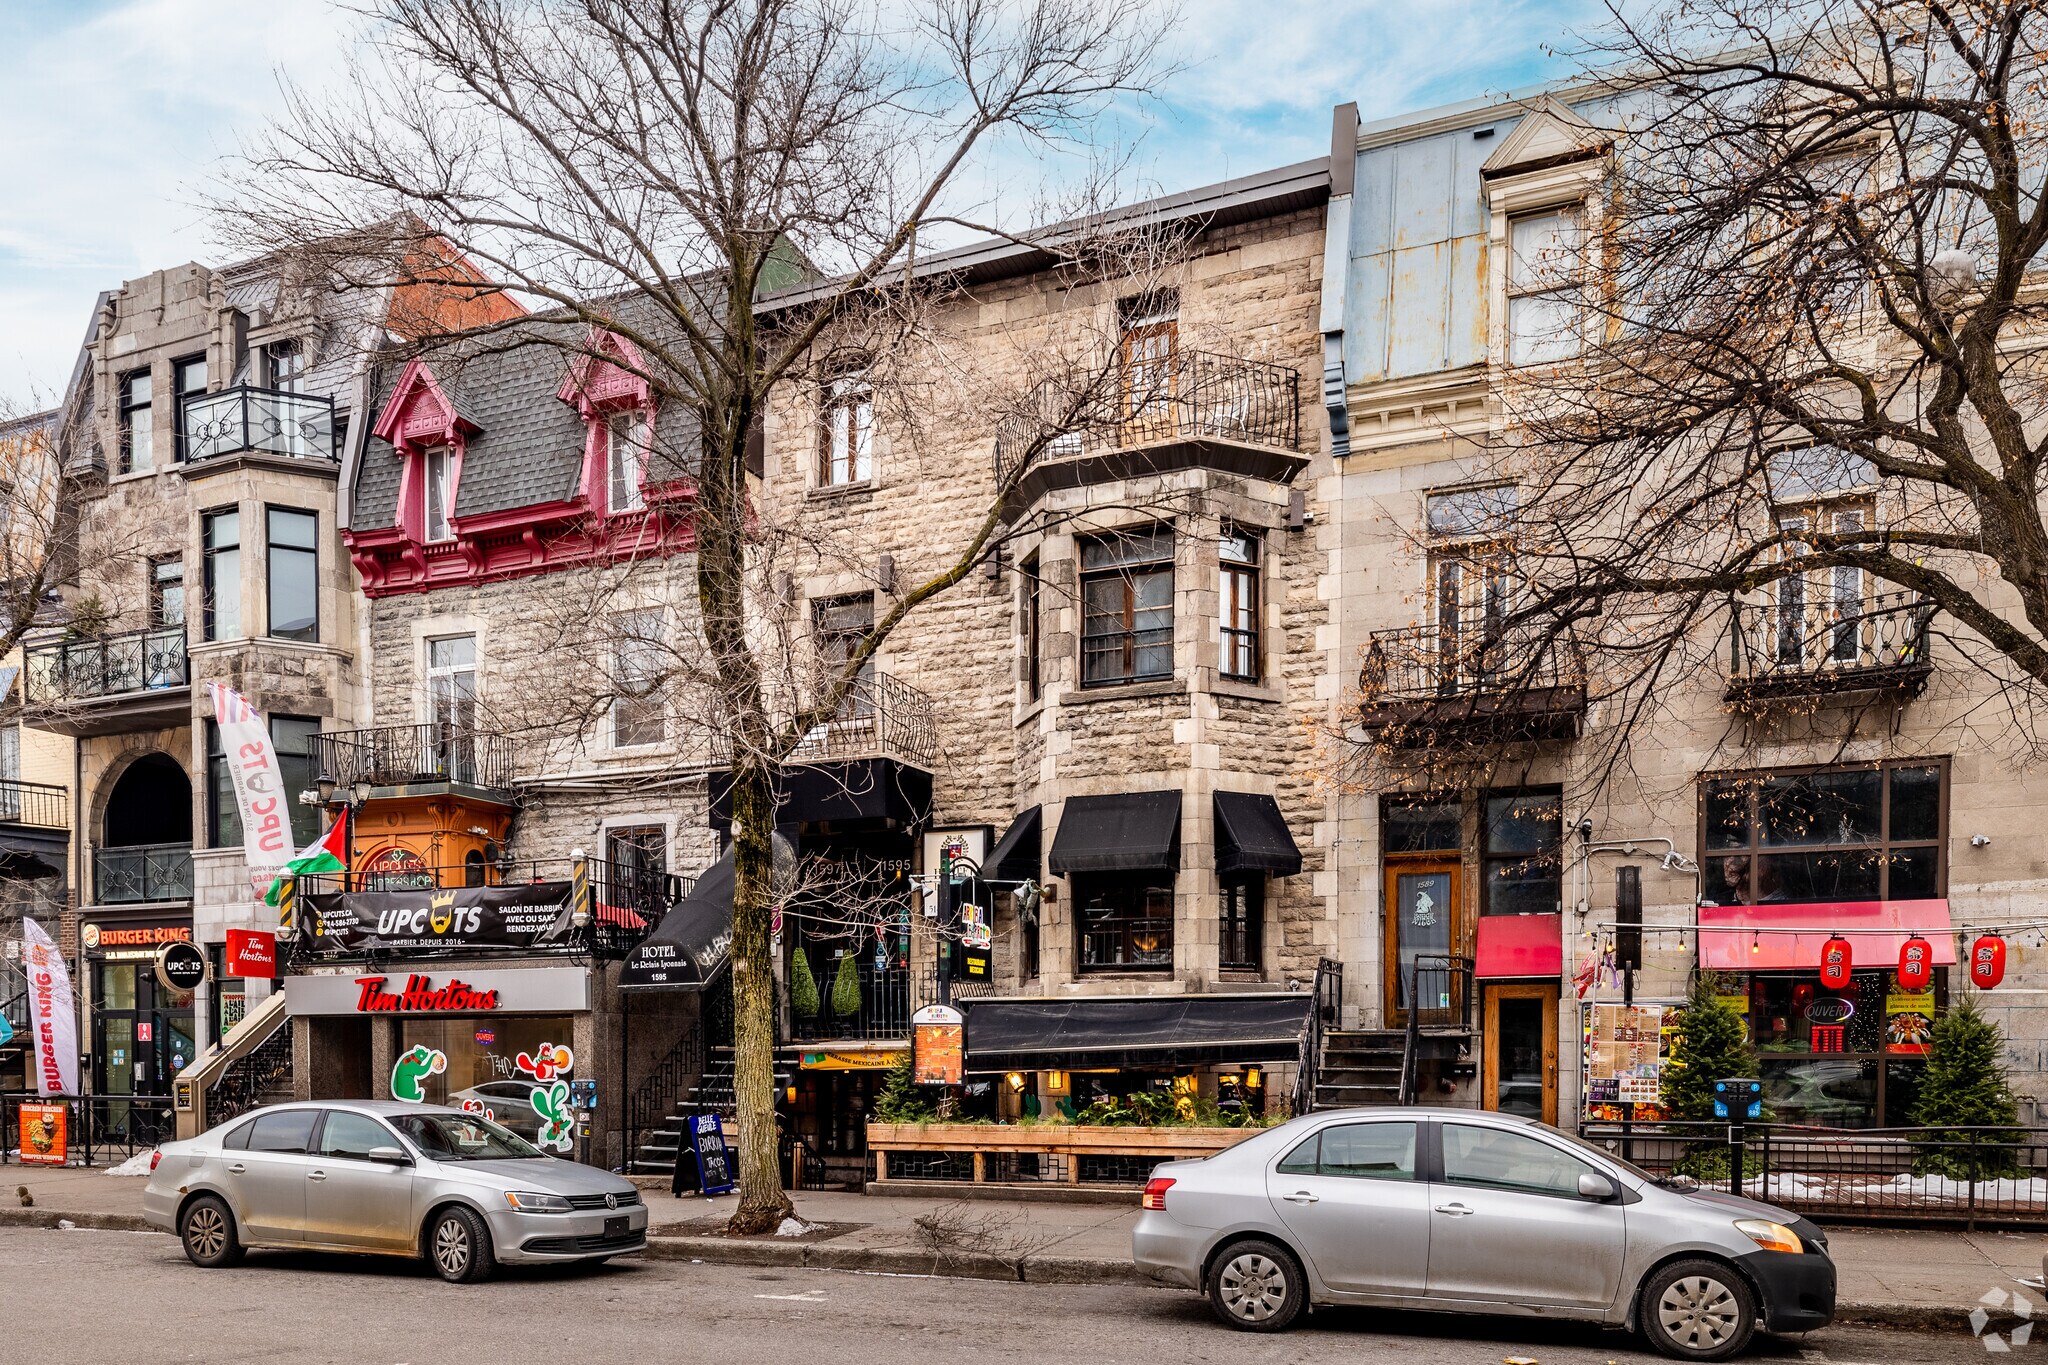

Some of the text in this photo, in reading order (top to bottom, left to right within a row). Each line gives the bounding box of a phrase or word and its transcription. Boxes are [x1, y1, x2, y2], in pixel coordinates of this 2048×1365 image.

[882, 859, 911, 871] 1595
[1416, 880, 1435, 889] 1589
[498, 904, 522, 914] SALON
[523, 905, 534, 913] DE
[505, 915, 525, 924] AVEC
[525, 915, 537, 923] OU
[100, 927, 190, 946] BURGER KING
[248, 937, 264, 951] Tim
[239, 949, 272, 964] Hortons
[641, 945, 676, 958] HOTEL
[631, 959, 687, 970] Le Relais Lyonnais
[651, 973, 667, 981] 1595
[34, 972, 53, 1017] KING
[355, 973, 499, 1011] Tim Hortons
[1806, 1004, 1850, 1017] OUVERT
[40, 1022, 63, 1092] BURGER
[852, 1059, 885, 1067] MEXICAINE
[697, 1114, 714, 1125] BELLE
[696, 1121, 717, 1134] GUEULE
[706, 1156, 725, 1168] TACOS
